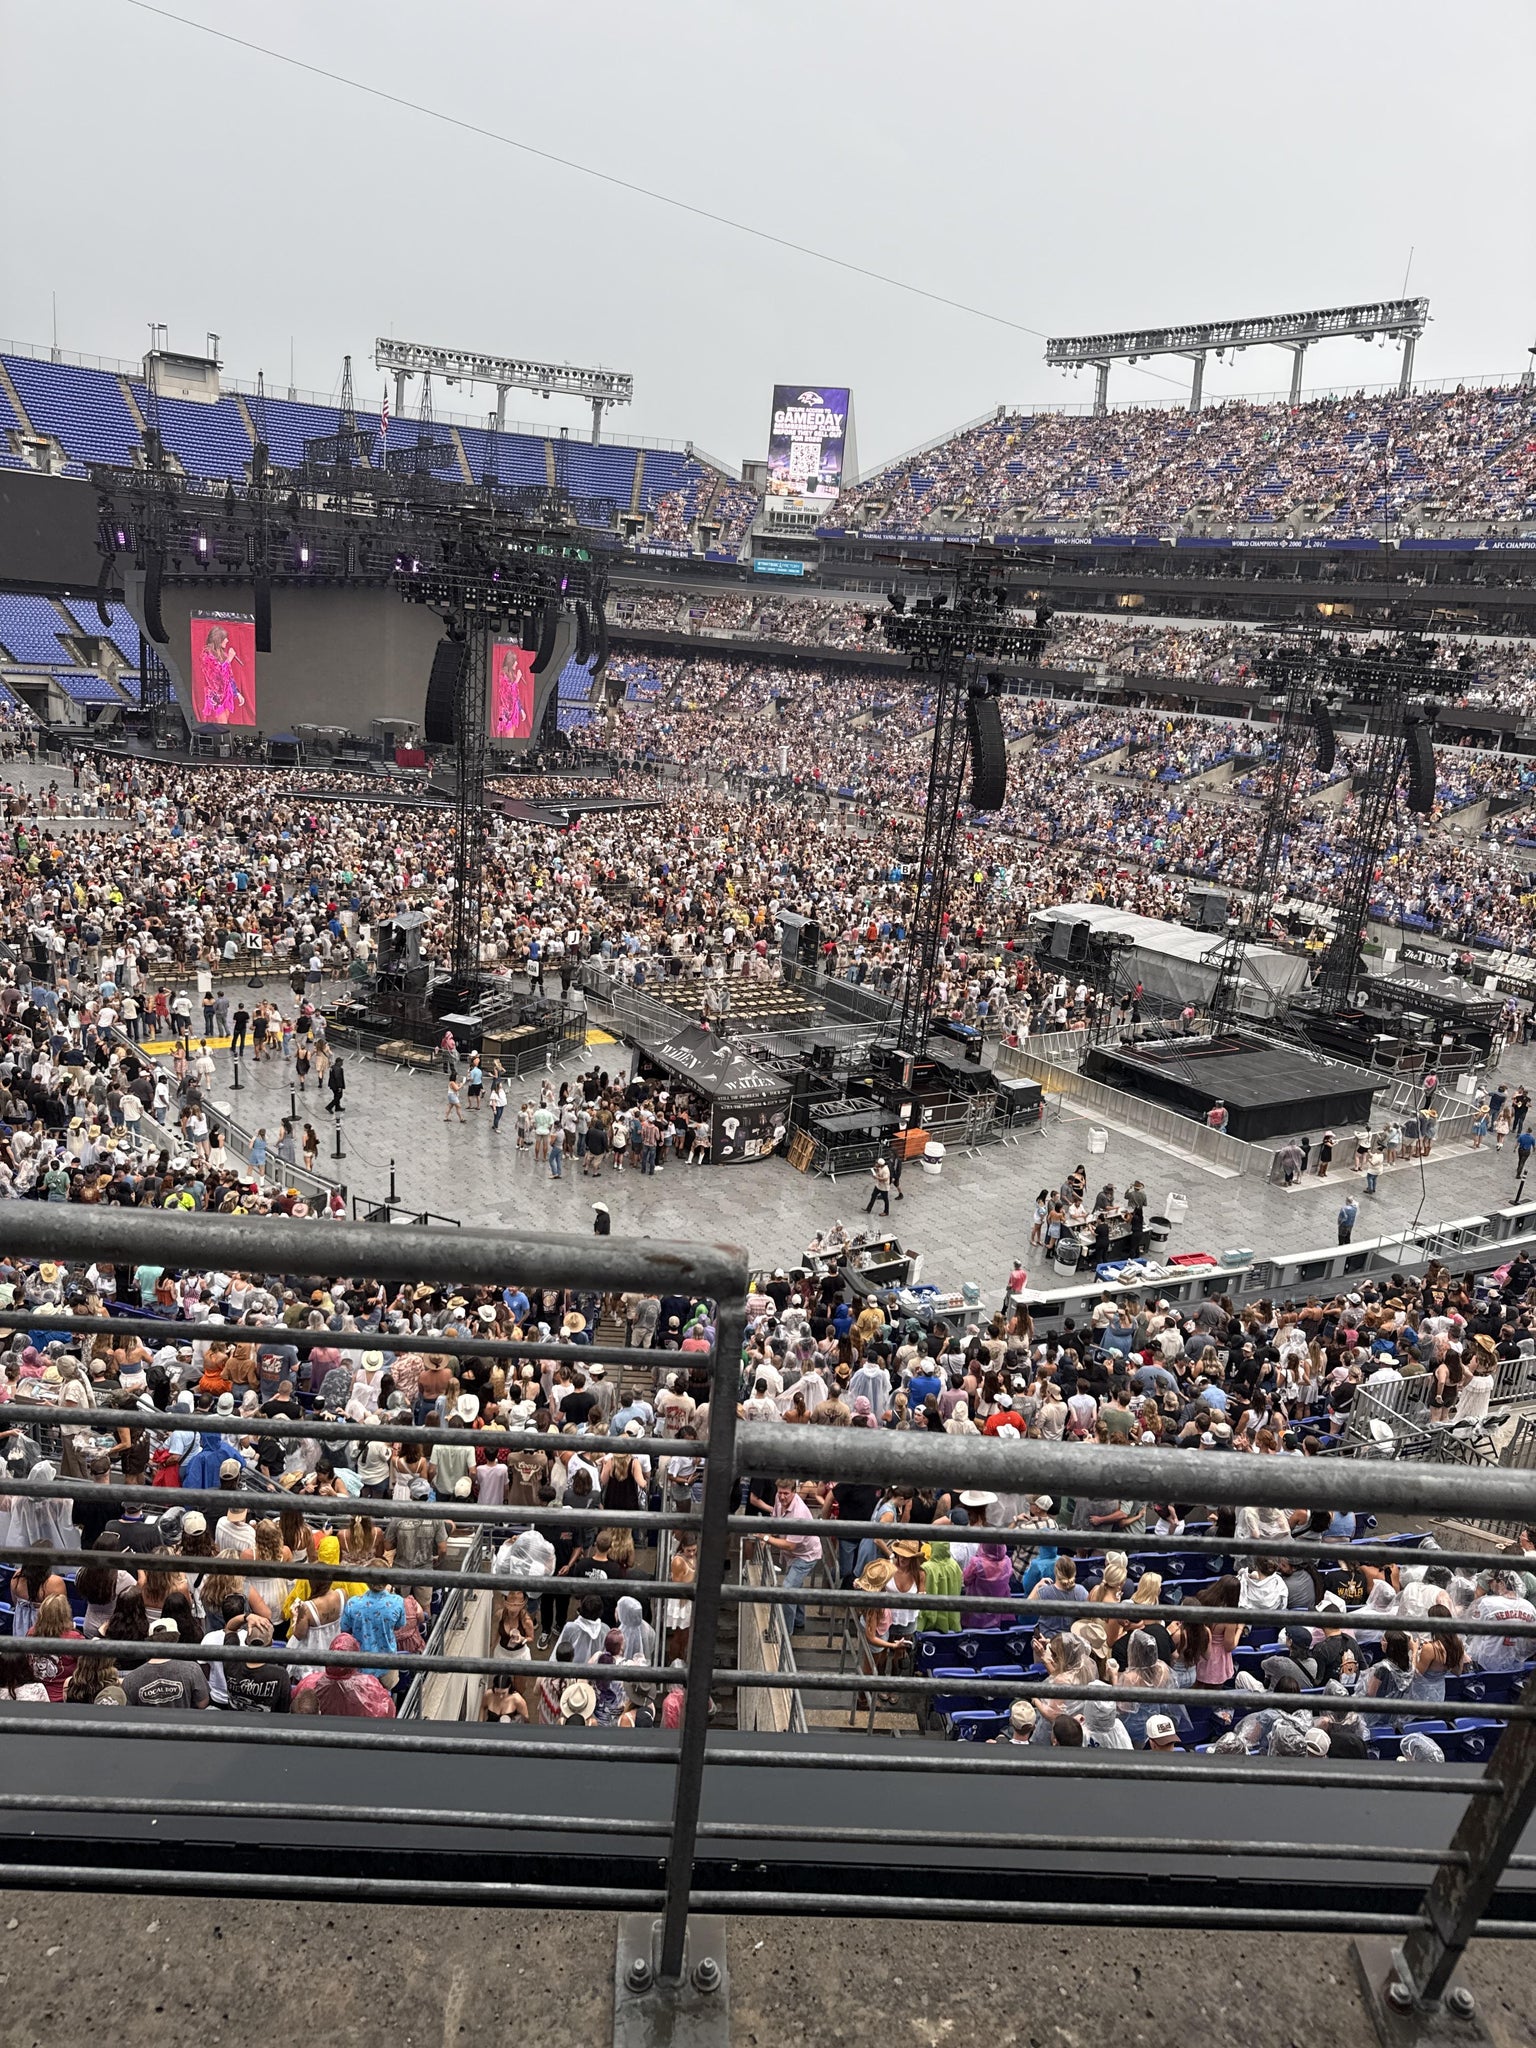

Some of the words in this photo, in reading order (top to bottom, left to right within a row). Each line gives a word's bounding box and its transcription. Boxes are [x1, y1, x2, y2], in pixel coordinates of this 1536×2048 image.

[774, 411, 844, 426] GAMEDAY
[1054, 537, 1068, 545] RING
[1231, 540, 1250, 548] WORLD
[1249, 540, 1279, 548] CHAMPIONS
[1492, 541, 1506, 549] AFC
[1505, 542, 1536, 550] CHAMPIO
[902, 865, 909, 874] B
[249, 935, 260, 948] K
[571, 932, 577, 944] J
[1404, 949, 1419, 960] The
[1417, 950, 1448, 968] TRUS
[1055, 986, 1062, 998] L
[660, 1044, 702, 1069] WALLEN
[724, 1077, 777, 1090] WALLEN
[143, 1686, 164, 1697] LOCAL
[165, 1686, 179, 1694] BOY
